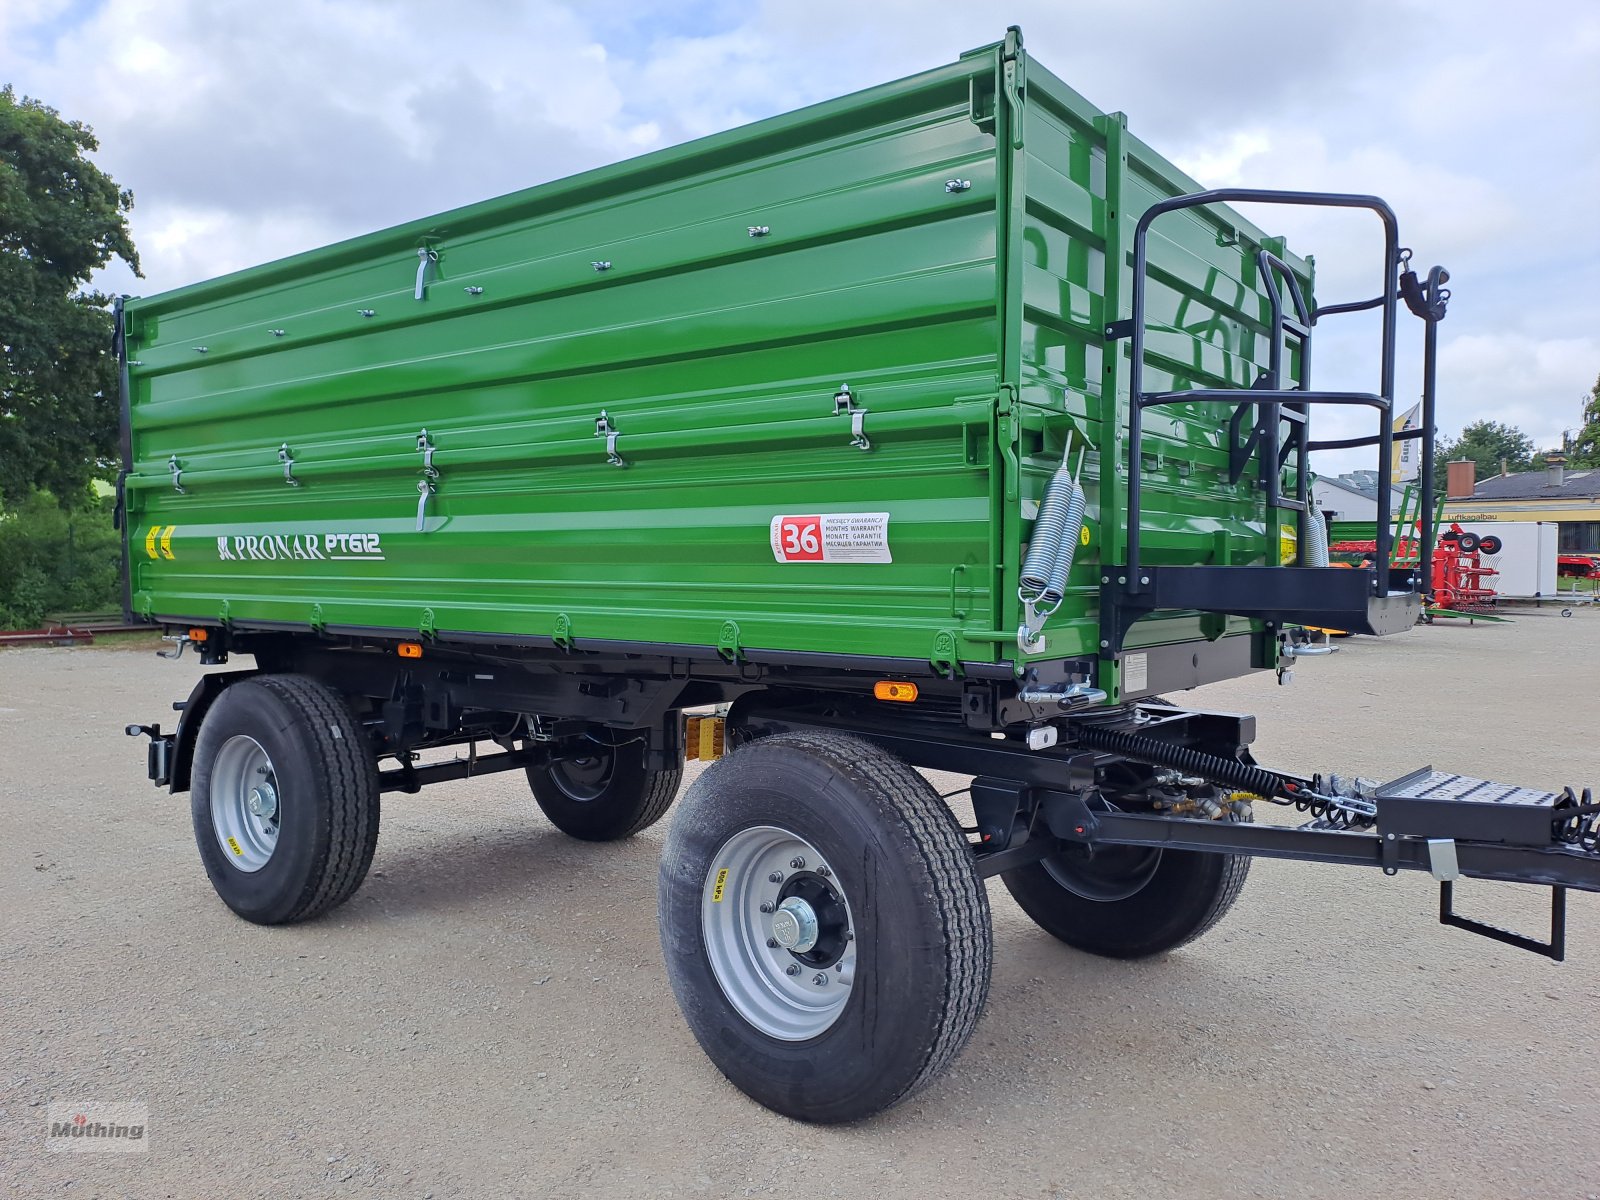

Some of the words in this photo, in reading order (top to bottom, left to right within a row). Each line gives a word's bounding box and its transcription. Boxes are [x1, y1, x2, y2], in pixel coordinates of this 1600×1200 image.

[234, 534, 327, 561] PRONAR
[325, 534, 382, 553] PT612
[783, 523, 820, 554] 36
[714, 885, 723, 900] kPa
